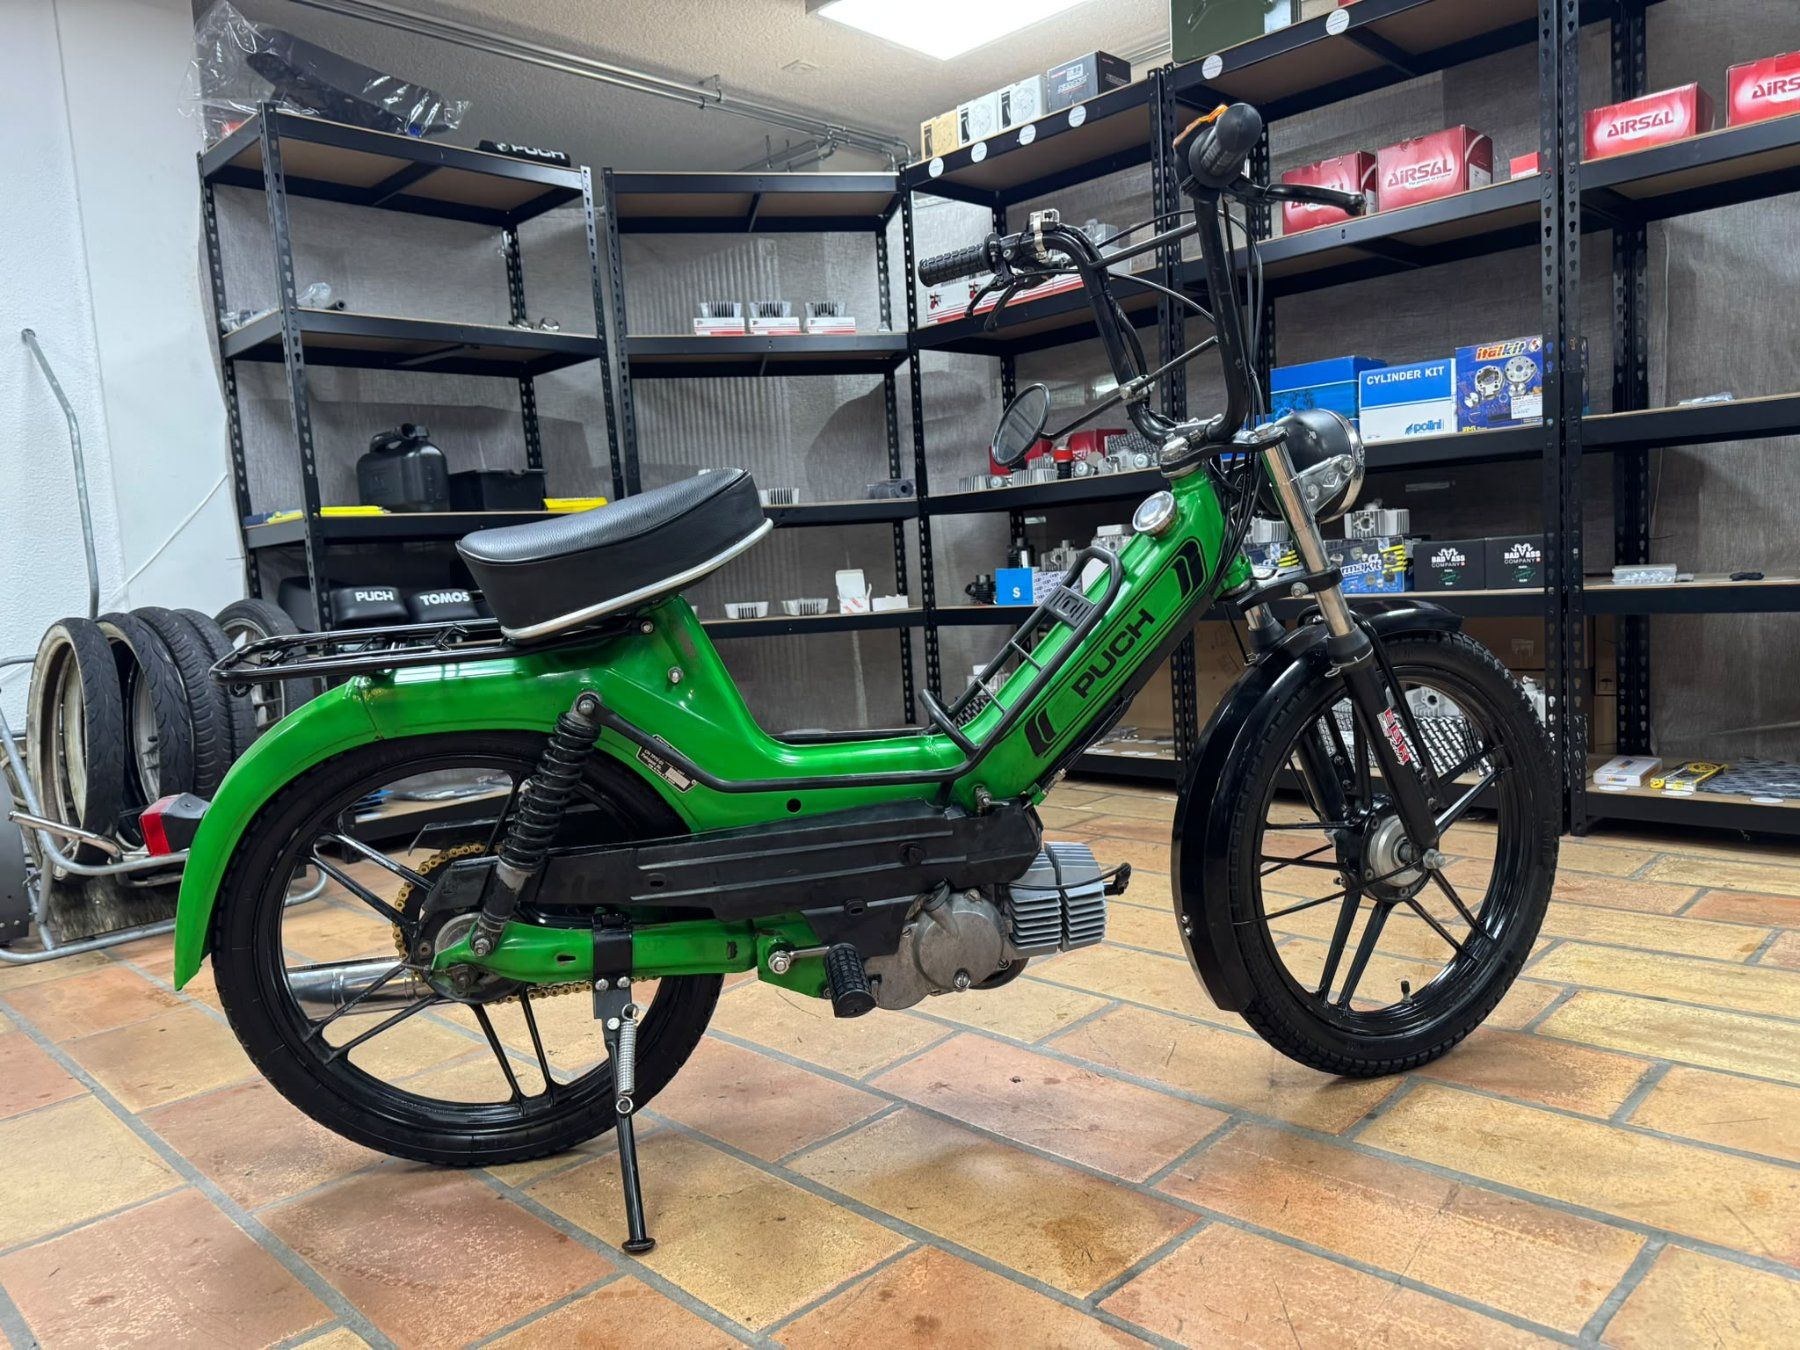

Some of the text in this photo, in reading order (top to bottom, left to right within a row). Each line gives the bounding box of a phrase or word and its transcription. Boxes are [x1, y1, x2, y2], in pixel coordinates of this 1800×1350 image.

[1366, 366, 1445, 385] CYLINDER KIT
[1413, 418, 1442, 434] polini
[1504, 557, 1535, 565] COMPANY
[355, 591, 394, 602] PUCH
[420, 591, 470, 606] TOMOS
[1071, 608, 1156, 699] PUCH
